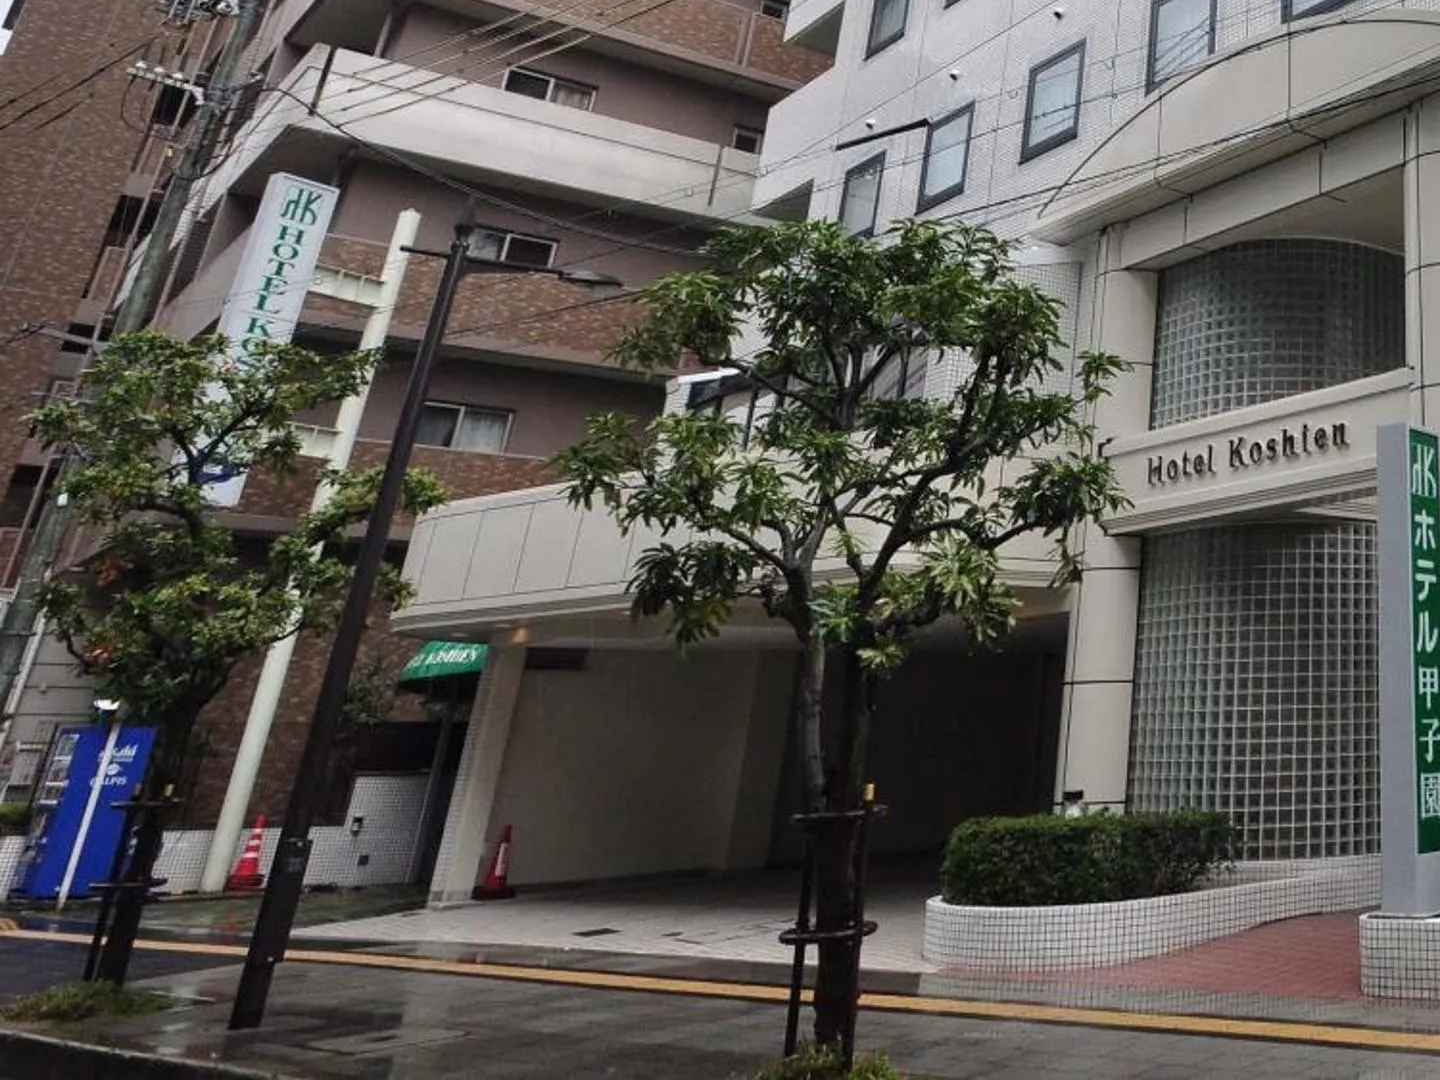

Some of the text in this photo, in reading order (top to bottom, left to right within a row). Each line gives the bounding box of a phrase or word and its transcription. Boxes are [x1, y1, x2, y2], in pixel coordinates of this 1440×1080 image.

[253, 225, 305, 315] HOTEL
[1147, 422, 1351, 486] Hotel Koshien
